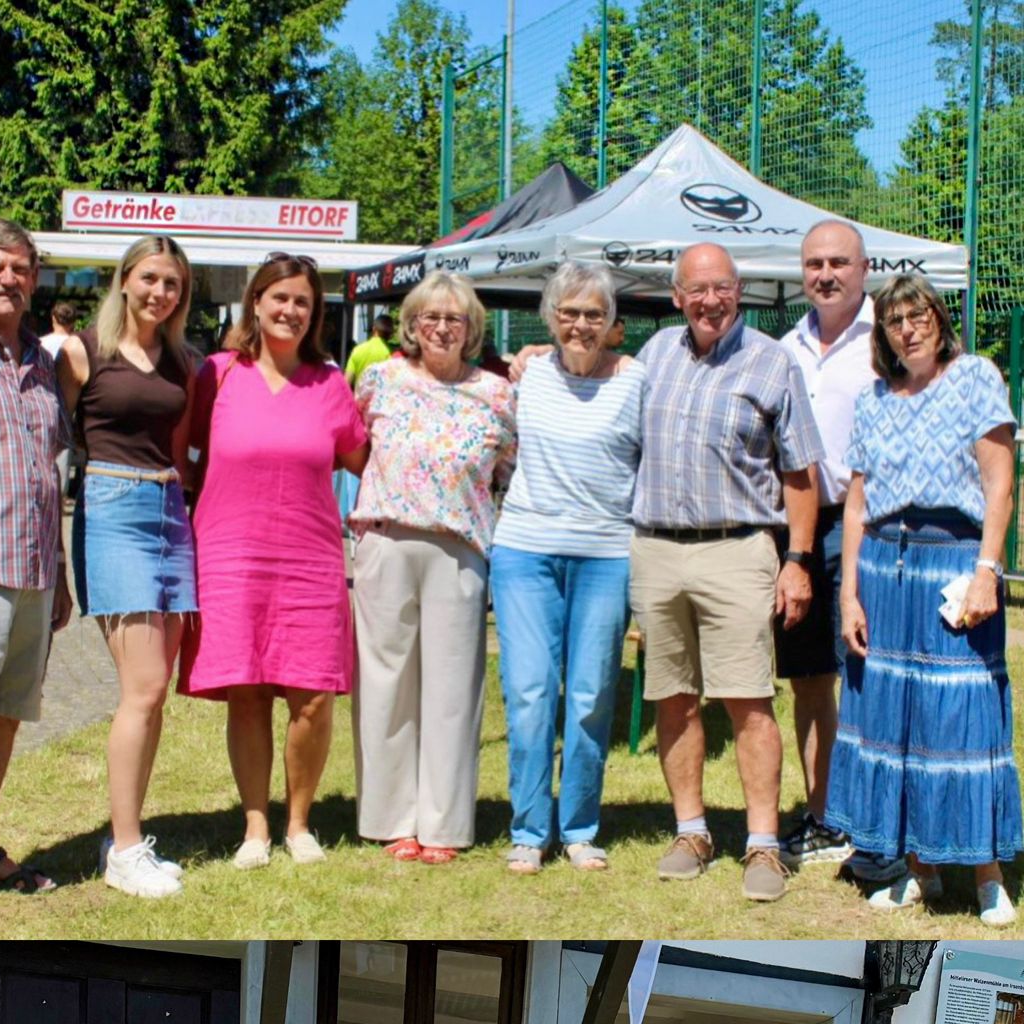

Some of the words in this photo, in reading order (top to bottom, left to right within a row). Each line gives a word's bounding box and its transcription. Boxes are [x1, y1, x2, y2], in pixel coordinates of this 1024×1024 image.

[72, 196, 176, 221] Getränke
[277, 205, 349, 227] EITORF
[635, 249, 681, 264] 24
[392, 263, 422, 284] 24MX
